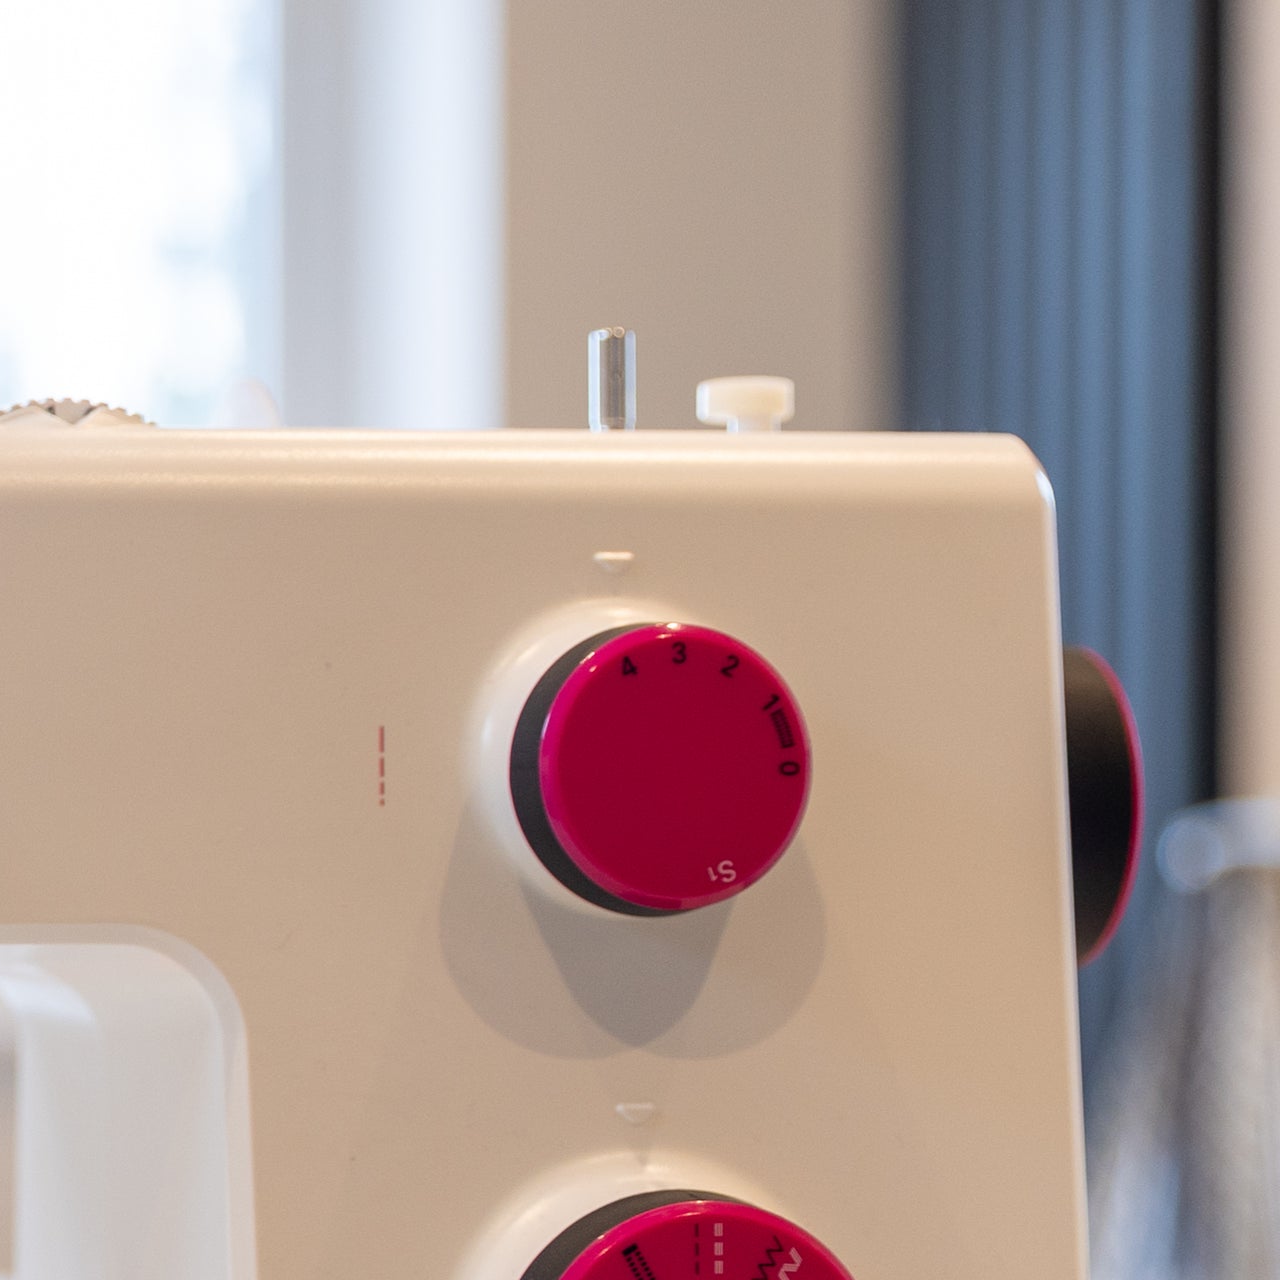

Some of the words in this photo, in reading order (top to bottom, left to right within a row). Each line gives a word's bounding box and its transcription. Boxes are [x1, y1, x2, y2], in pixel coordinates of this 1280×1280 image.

[672, 641, 687, 664] 3
[621, 655, 638, 677] 4
[720, 654, 740, 678] 2
[762, 693, 781, 712] 1
[779, 760, 801, 777] 0
[707, 859, 737, 883] S1
